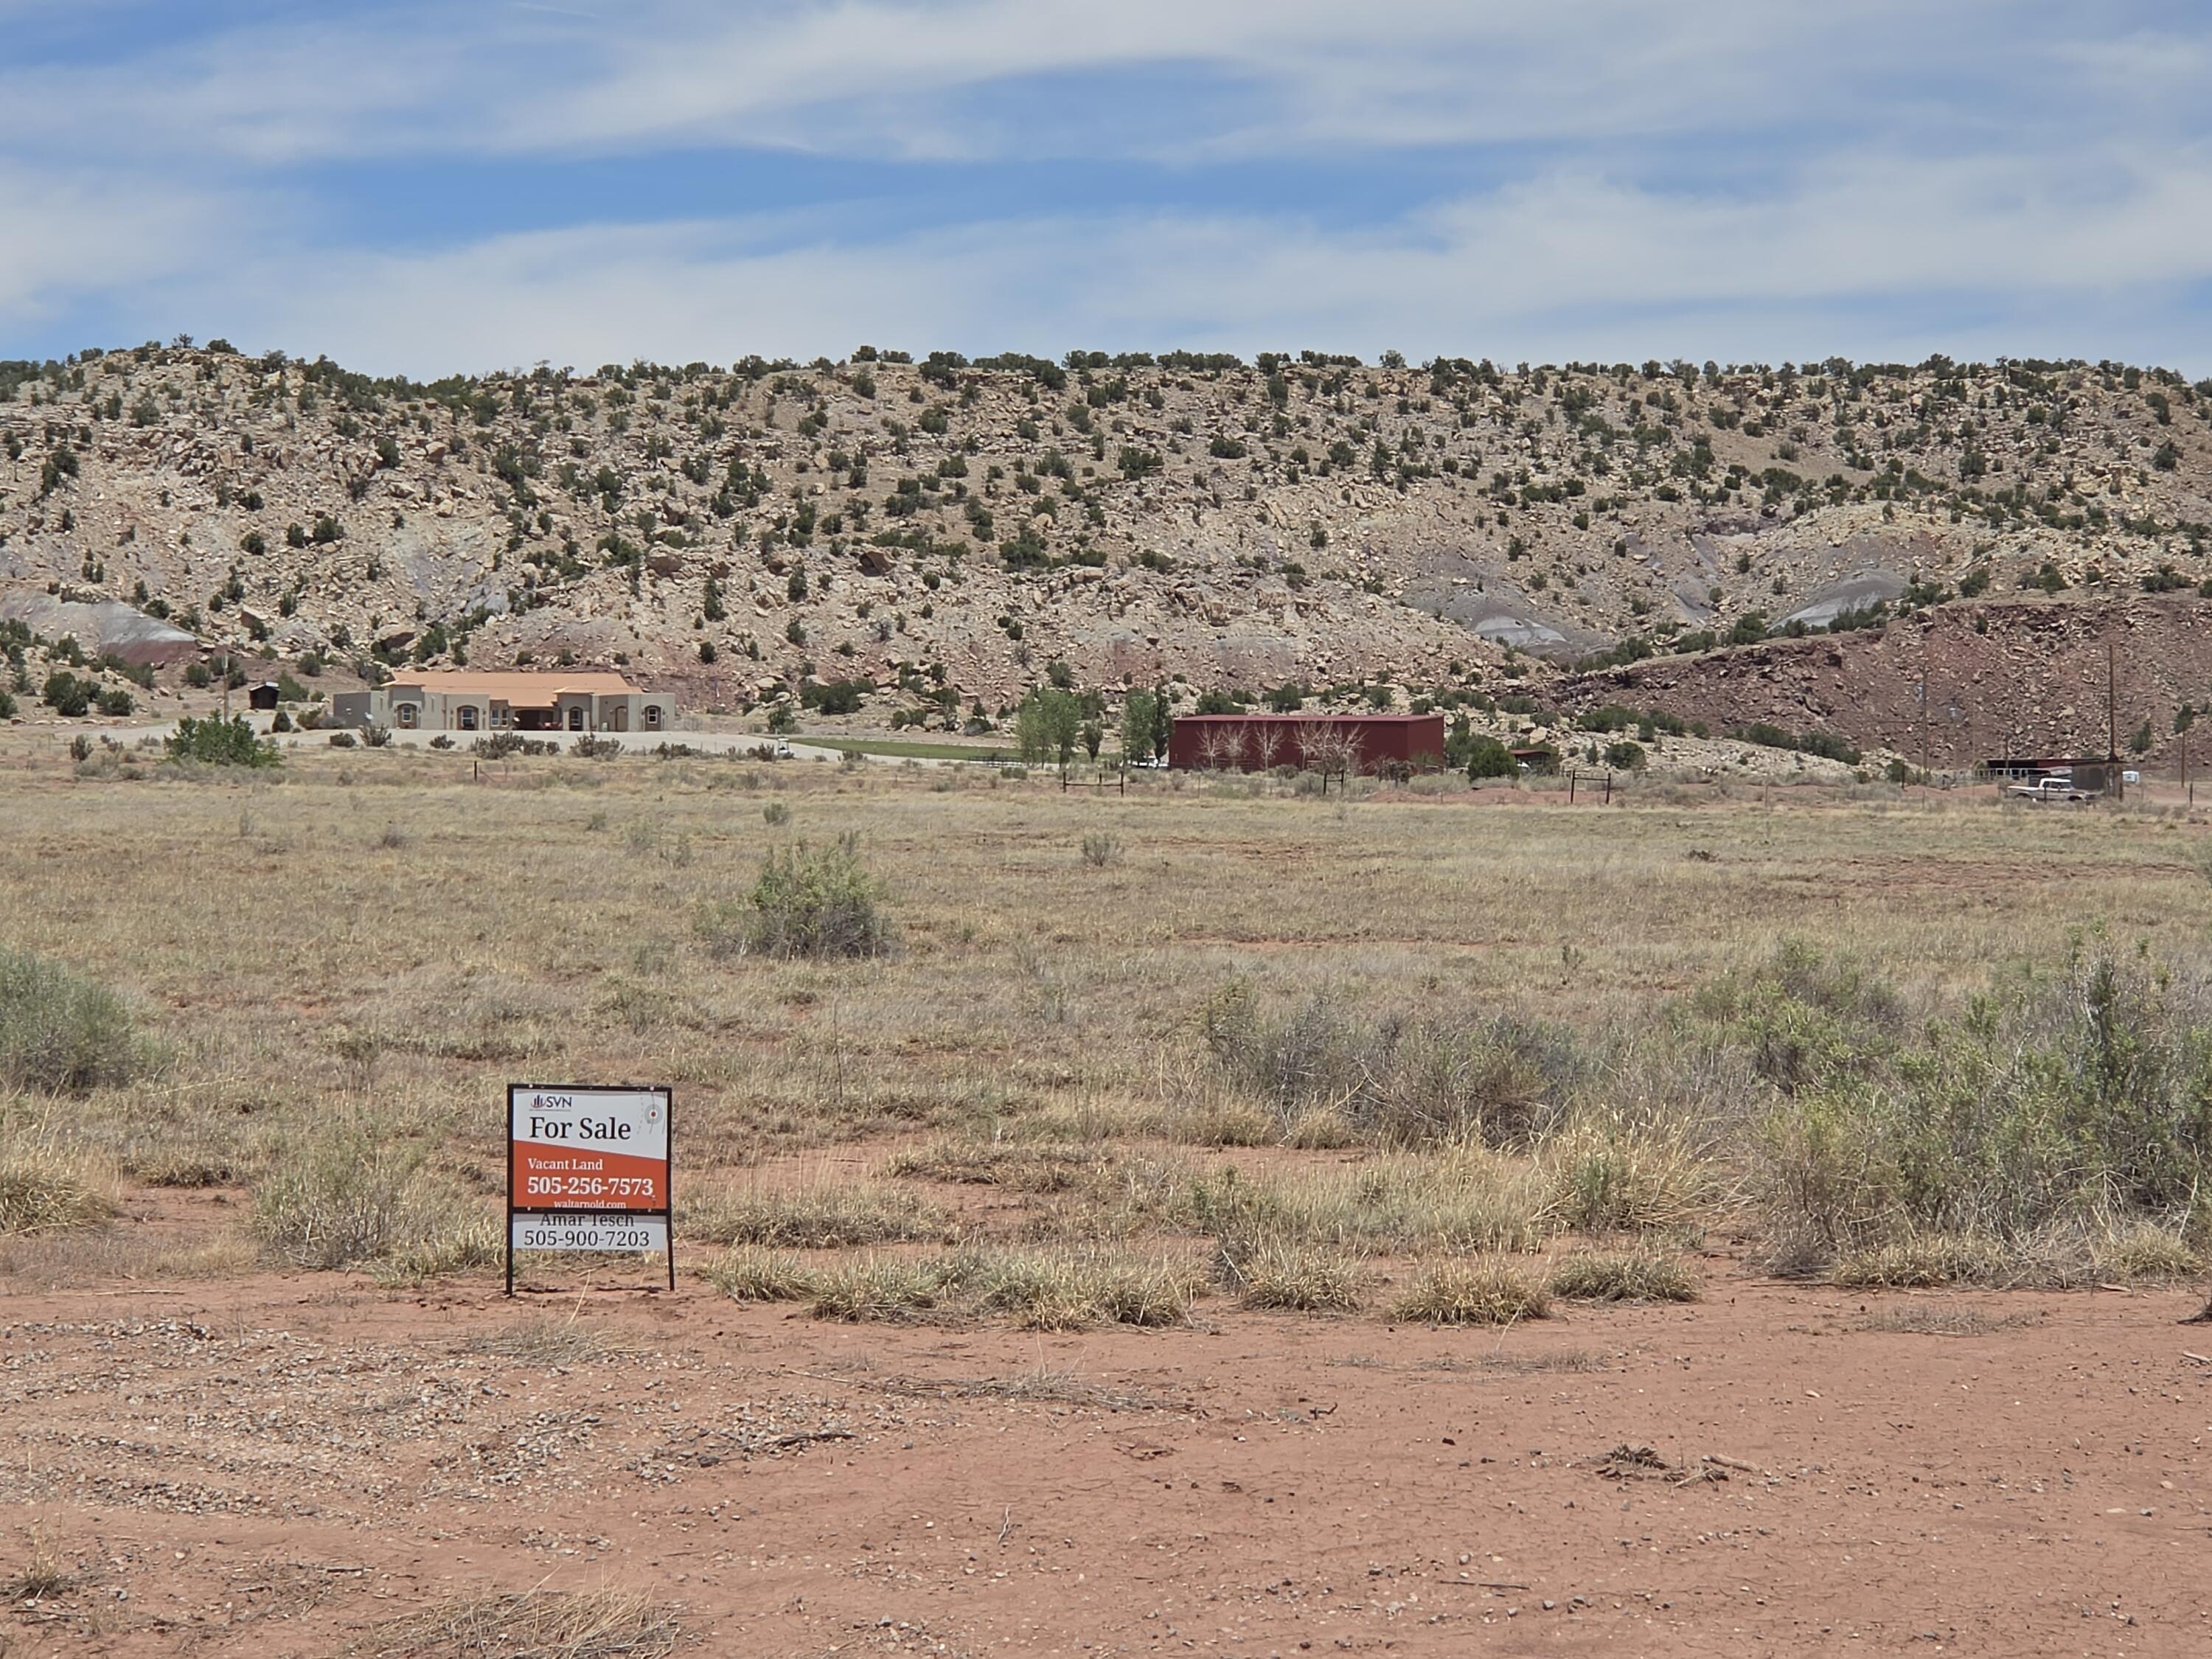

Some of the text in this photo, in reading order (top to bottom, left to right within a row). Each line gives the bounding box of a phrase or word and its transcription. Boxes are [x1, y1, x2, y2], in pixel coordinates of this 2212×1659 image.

[546, 1096, 572, 1107] SVN
[529, 1116, 631, 1140] For Sale
[527, 1158, 603, 1170] Vacant Land
[527, 1176, 654, 1196] 505-256-7573
[554, 1199, 627, 1209] waltarnold.com
[540, 1213, 634, 1227] Amar Tesch
[524, 1230, 650, 1247] 505-900-7203
